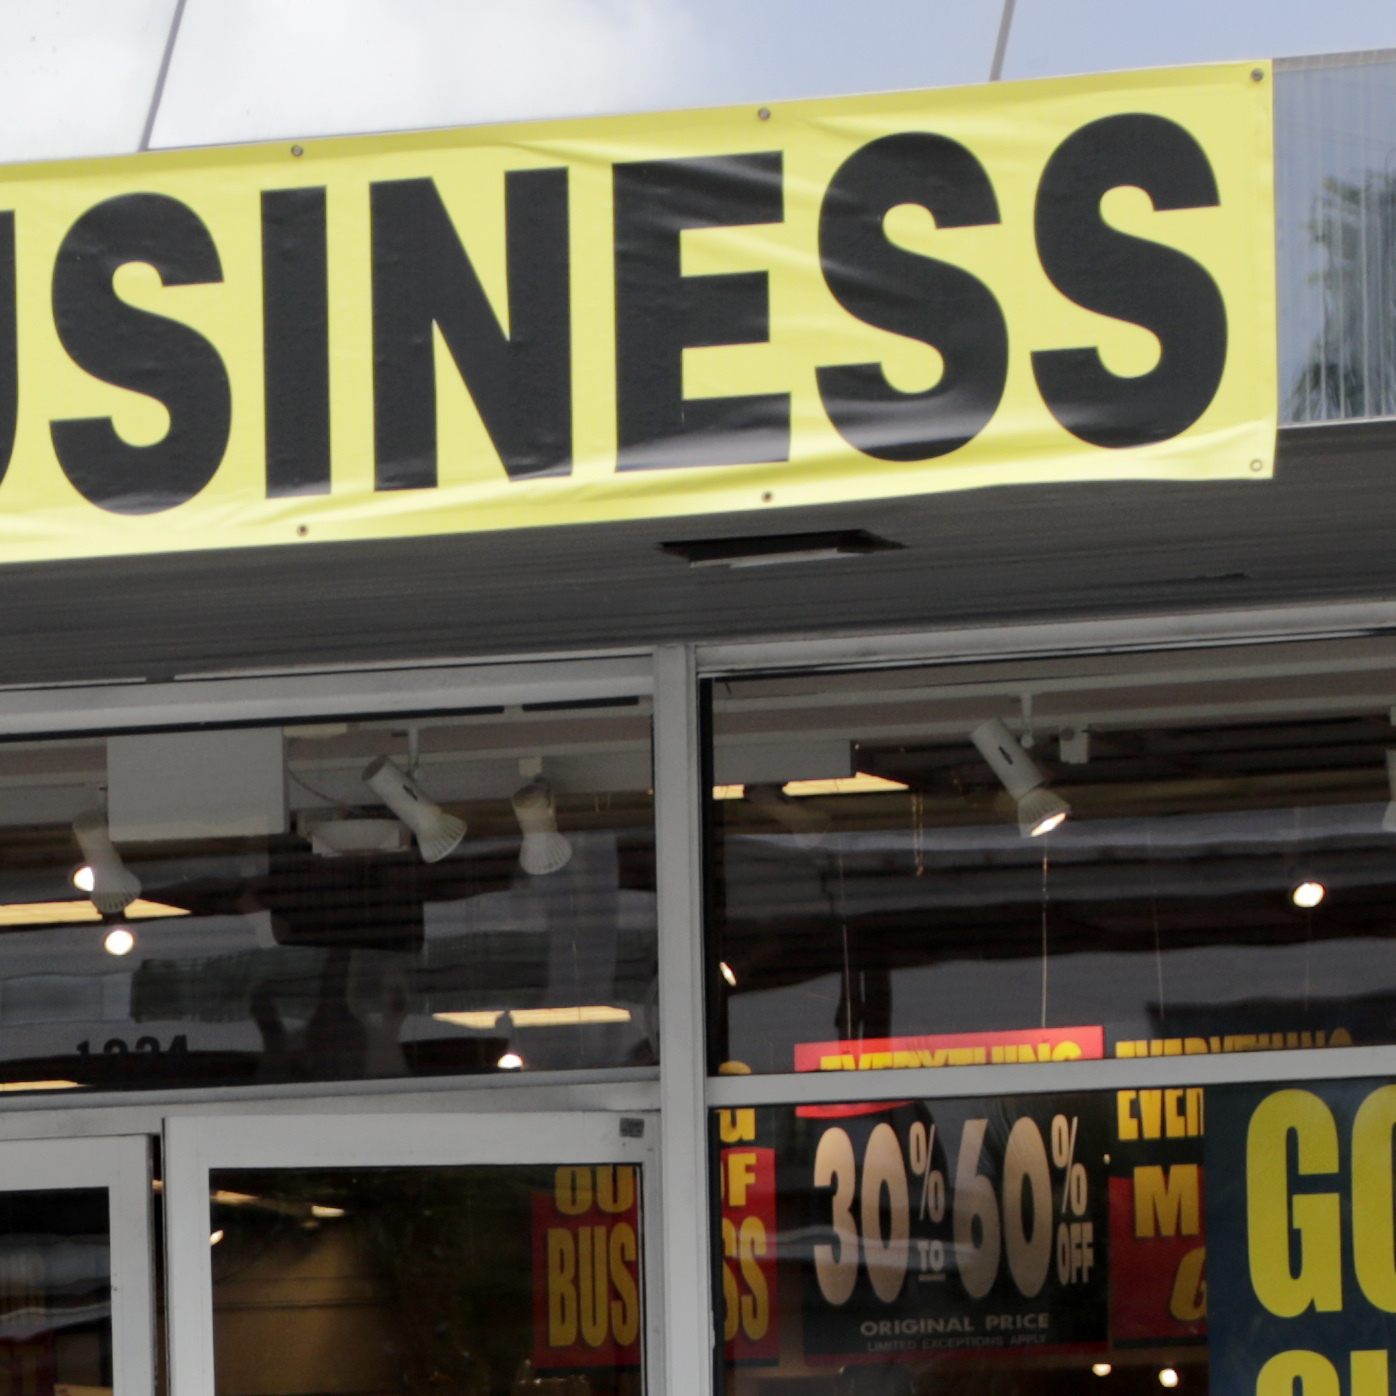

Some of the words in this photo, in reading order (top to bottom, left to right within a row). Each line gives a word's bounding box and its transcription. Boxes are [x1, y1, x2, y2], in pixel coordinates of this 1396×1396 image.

[814, 1119, 945, 1305] 30%
[918, 1243, 944, 1272] TO
[953, 1112, 1087, 1298] 60%
[1057, 1220, 1094, 1287] OFF
[860, 1315, 975, 1337] ORIGINAL
[986, 1311, 1050, 1333] PRICE
[866, 1338, 916, 1352] LIMITED
[921, 1335, 1004, 1350] EXCEPTIONS
